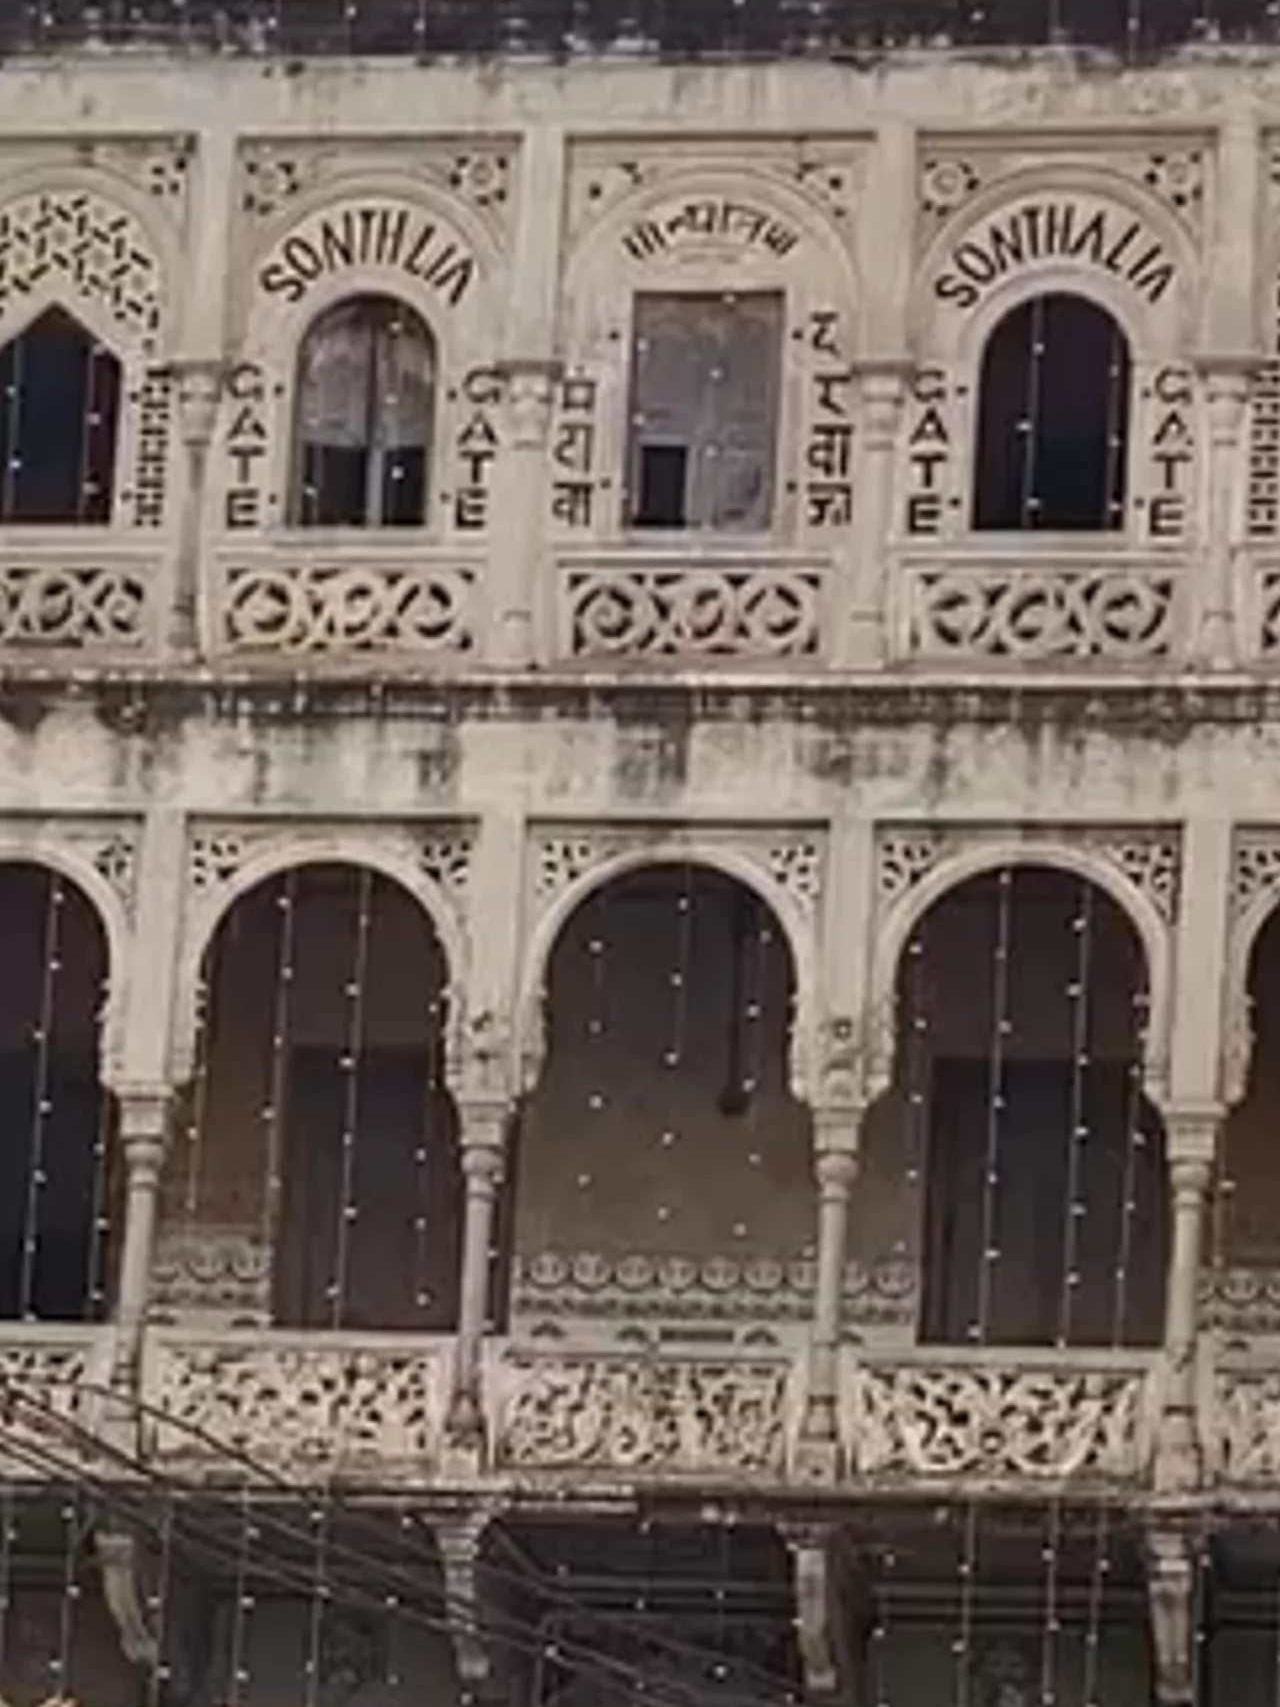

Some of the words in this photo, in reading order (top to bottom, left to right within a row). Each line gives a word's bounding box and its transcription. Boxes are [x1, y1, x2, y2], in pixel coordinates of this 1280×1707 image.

[934, 204, 1176, 309] SONTHALIA
[225, 362, 267, 530] GATE
[454, 366, 507, 530] GATE
[907, 368, 950, 535] GATE
[1149, 365, 1195, 536] GATE
